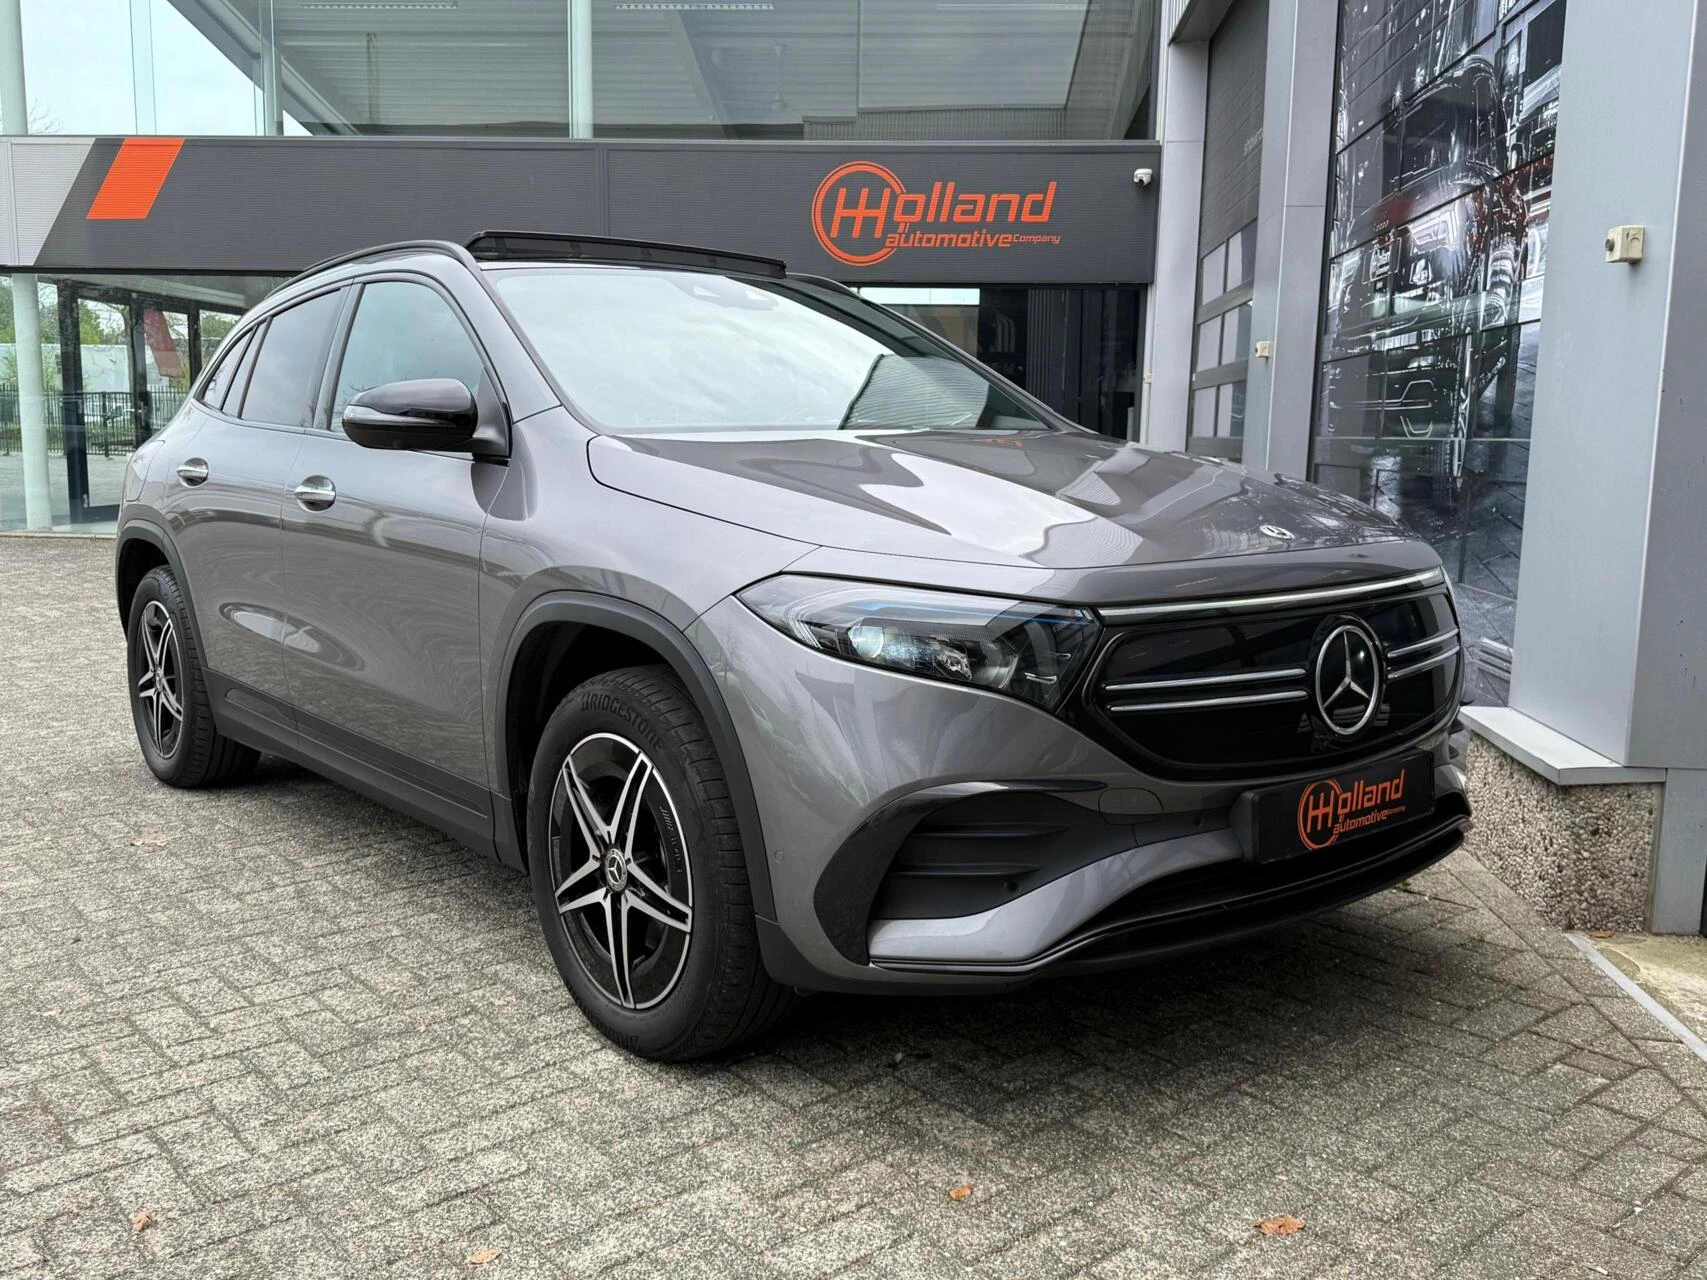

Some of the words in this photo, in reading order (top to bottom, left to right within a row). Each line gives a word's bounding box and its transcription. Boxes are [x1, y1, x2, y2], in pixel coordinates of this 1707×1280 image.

[830, 181, 1057, 239] Holland
[885, 228, 1011, 248] automotive
[1013, 232, 1061, 245] Company
[580, 691, 664, 753] BRIDGESTONE
[1306, 769, 1407, 834] Holland
[1333, 809, 1388, 835] automotive
